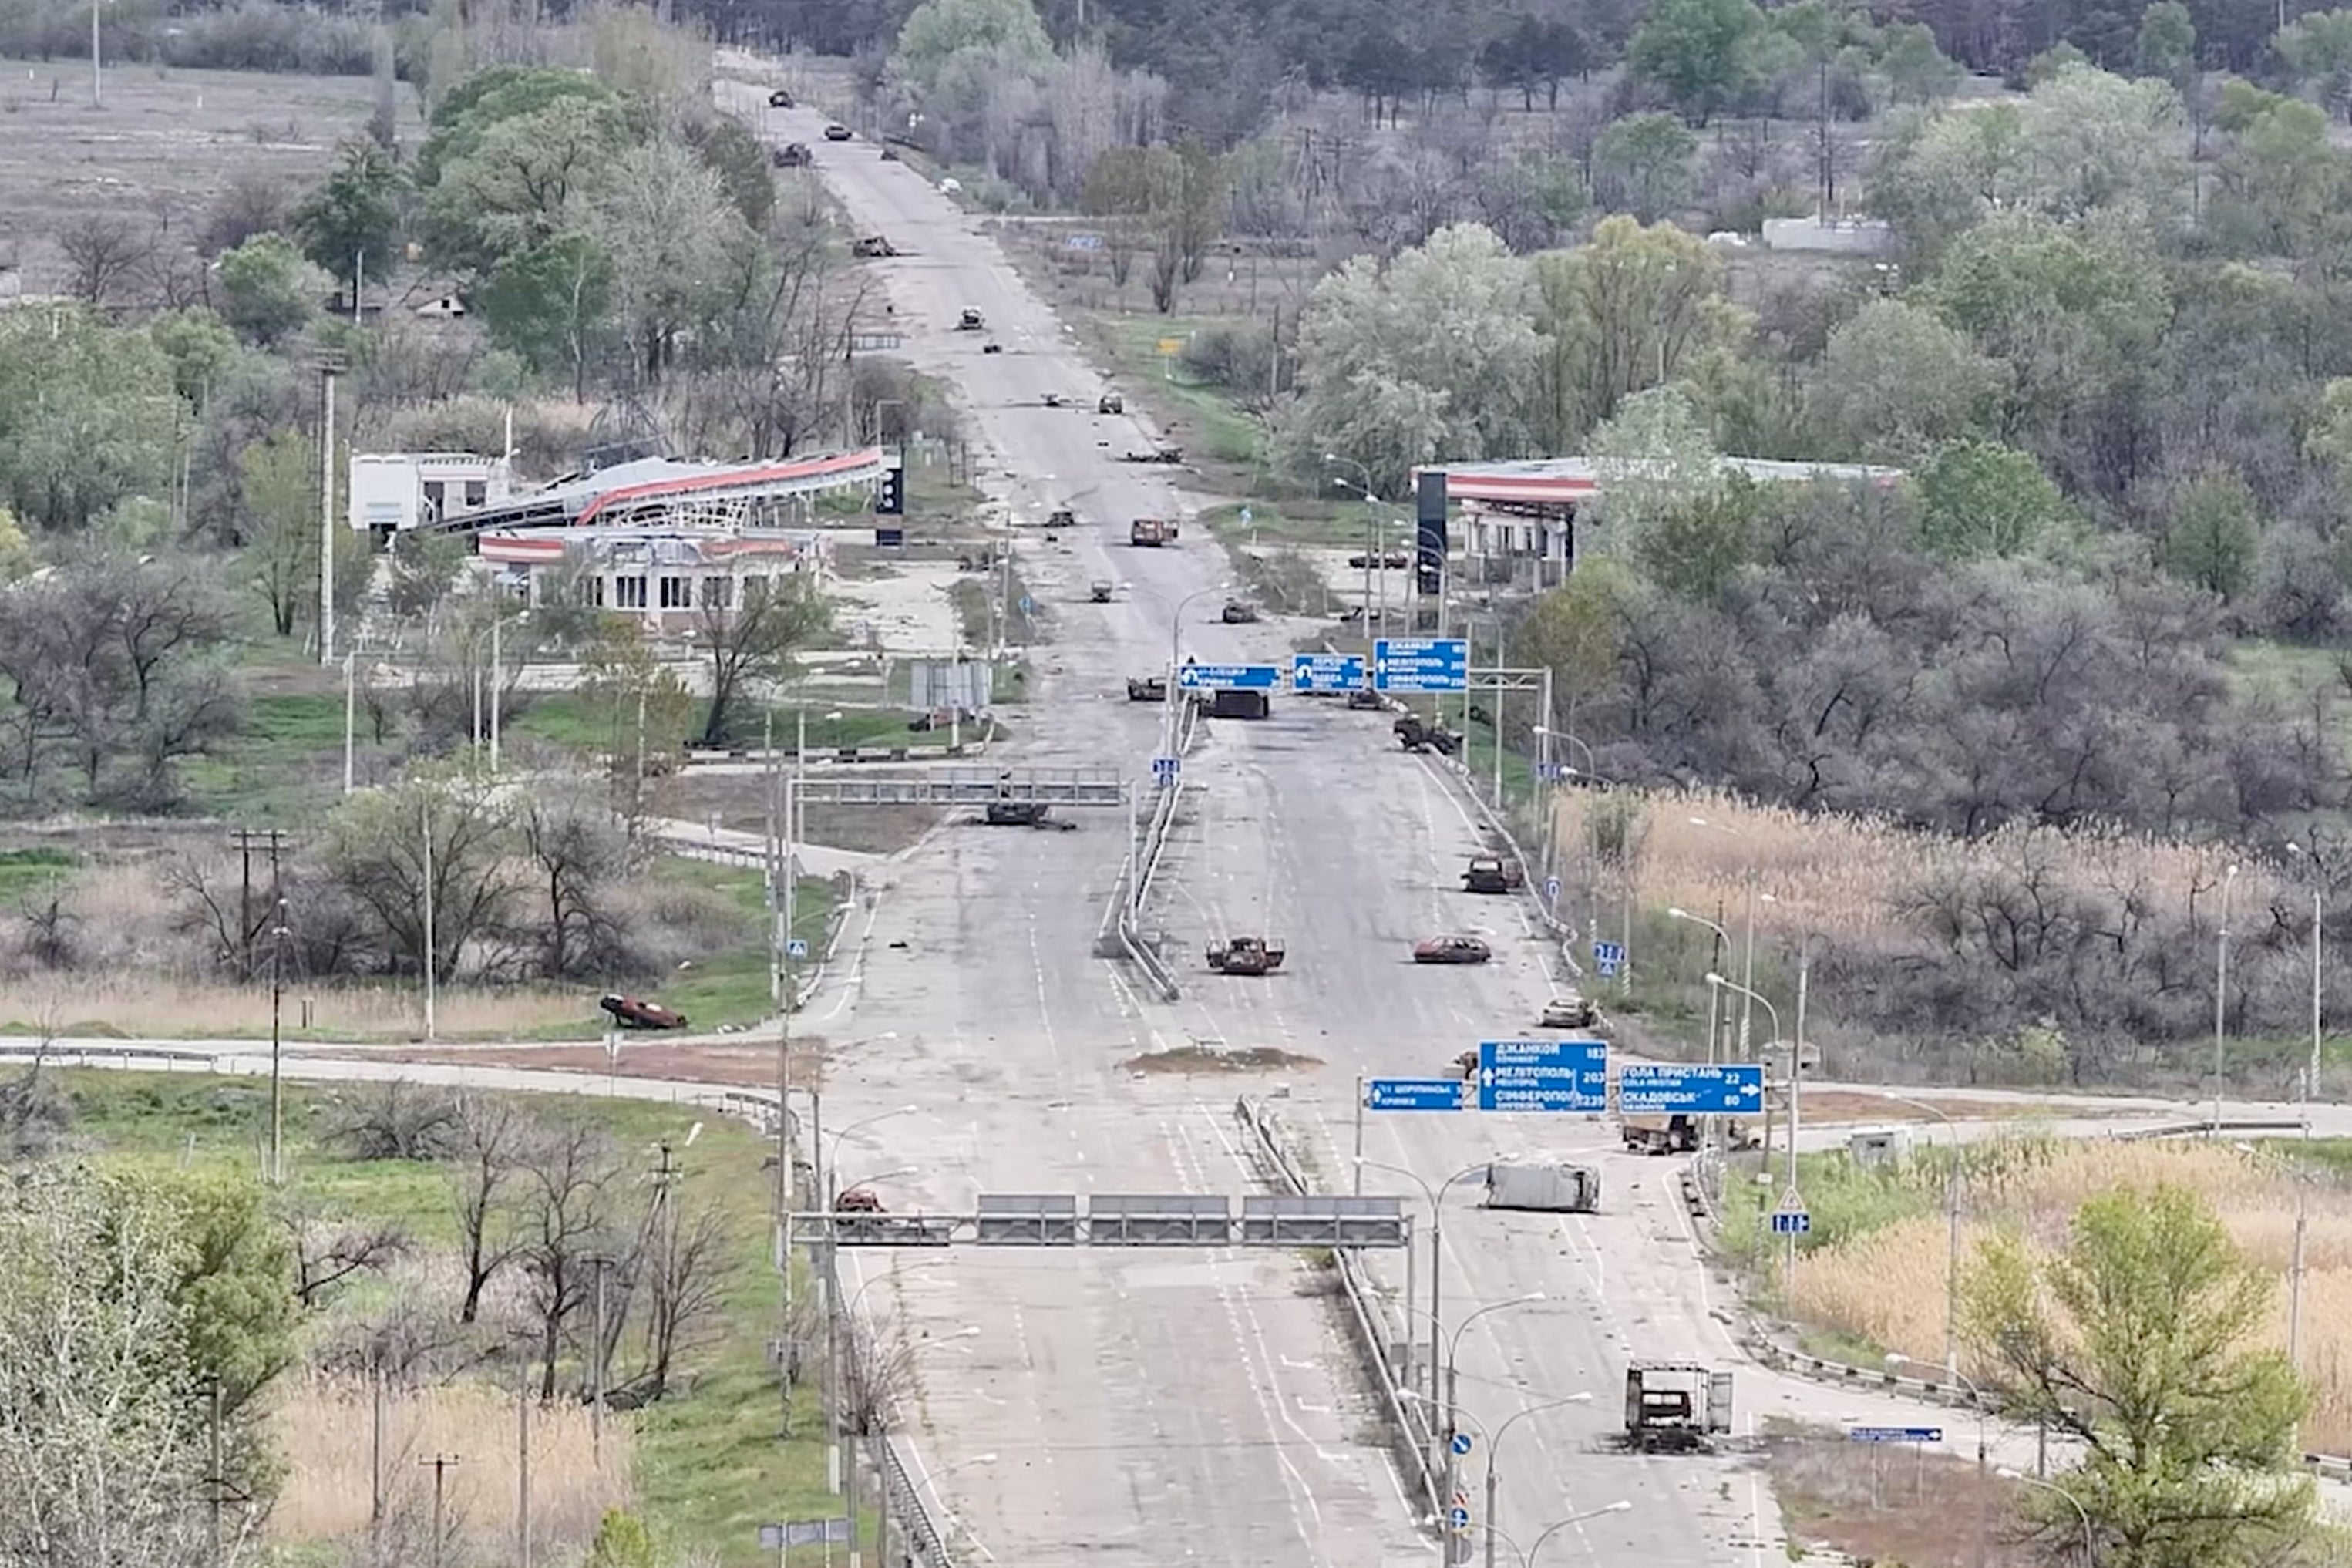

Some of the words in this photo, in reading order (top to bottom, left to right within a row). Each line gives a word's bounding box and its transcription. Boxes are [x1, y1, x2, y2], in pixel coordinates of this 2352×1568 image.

[1496, 1043, 1560, 1056] ДЖАНКОЙ
[1495, 1066, 1572, 1078] МЕЛІТОПОЛЬ
[1583, 1072, 1605, 1084] 203
[1623, 1067, 1655, 1078] ГОЛА
[1658, 1067, 1723, 1078] ПРИСТАНЬ
[1724, 1072, 1740, 1085] 22
[1623, 1092, 1696, 1103] СКАДОВСЬК
[1724, 1095, 1741, 1106] 80
